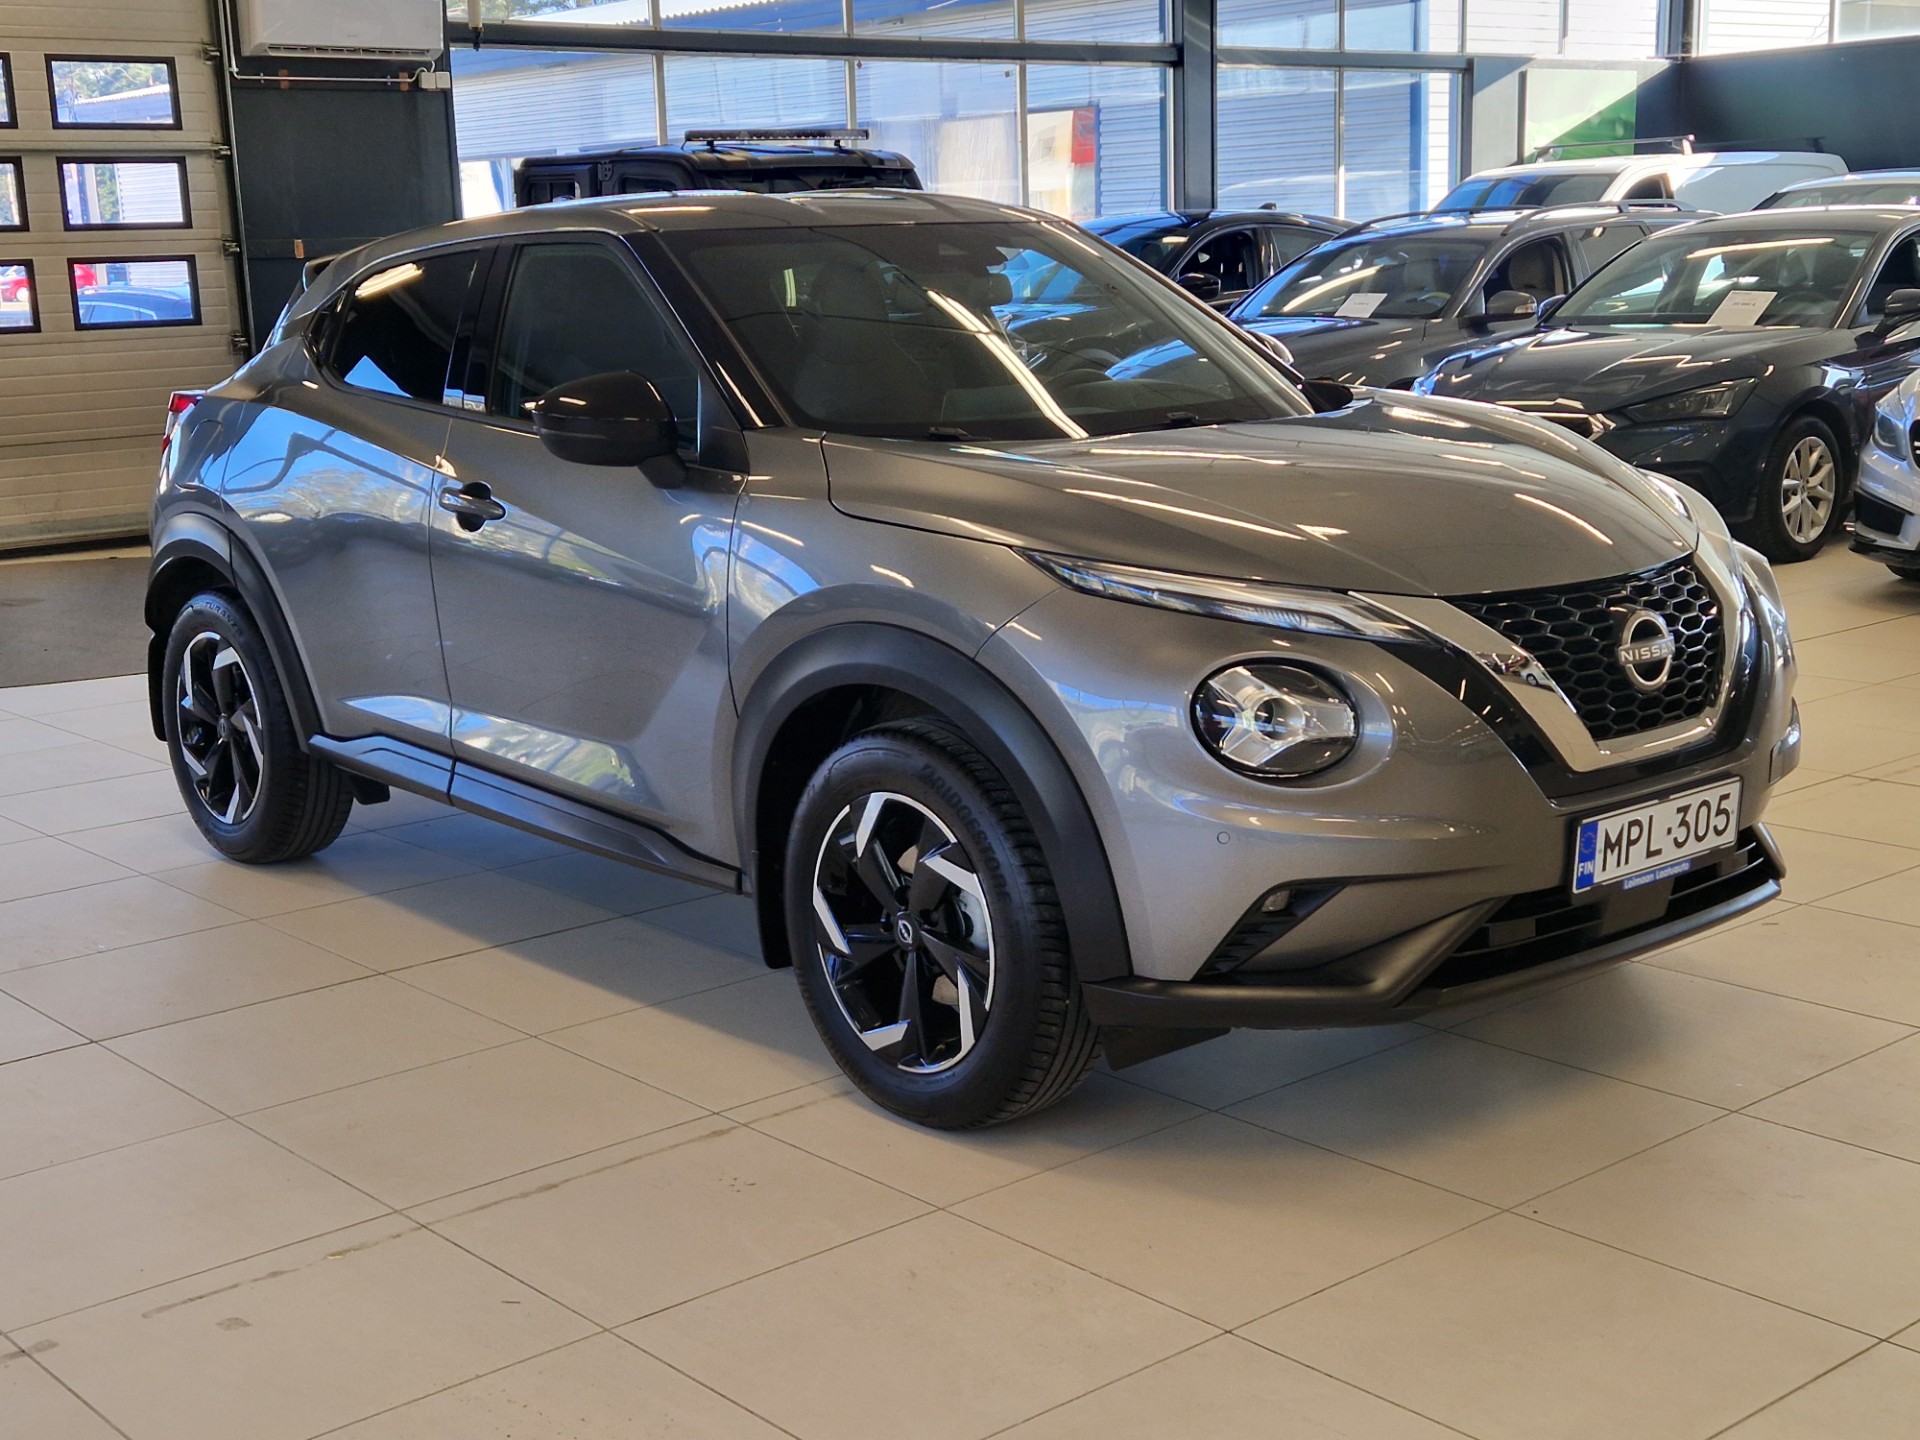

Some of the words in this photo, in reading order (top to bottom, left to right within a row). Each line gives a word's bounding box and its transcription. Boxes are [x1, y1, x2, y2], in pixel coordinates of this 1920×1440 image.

[1620, 641, 1675, 662] NISSAN
[1577, 860, 1595, 878] FIN
[1623, 873, 1655, 890] Loimaan
